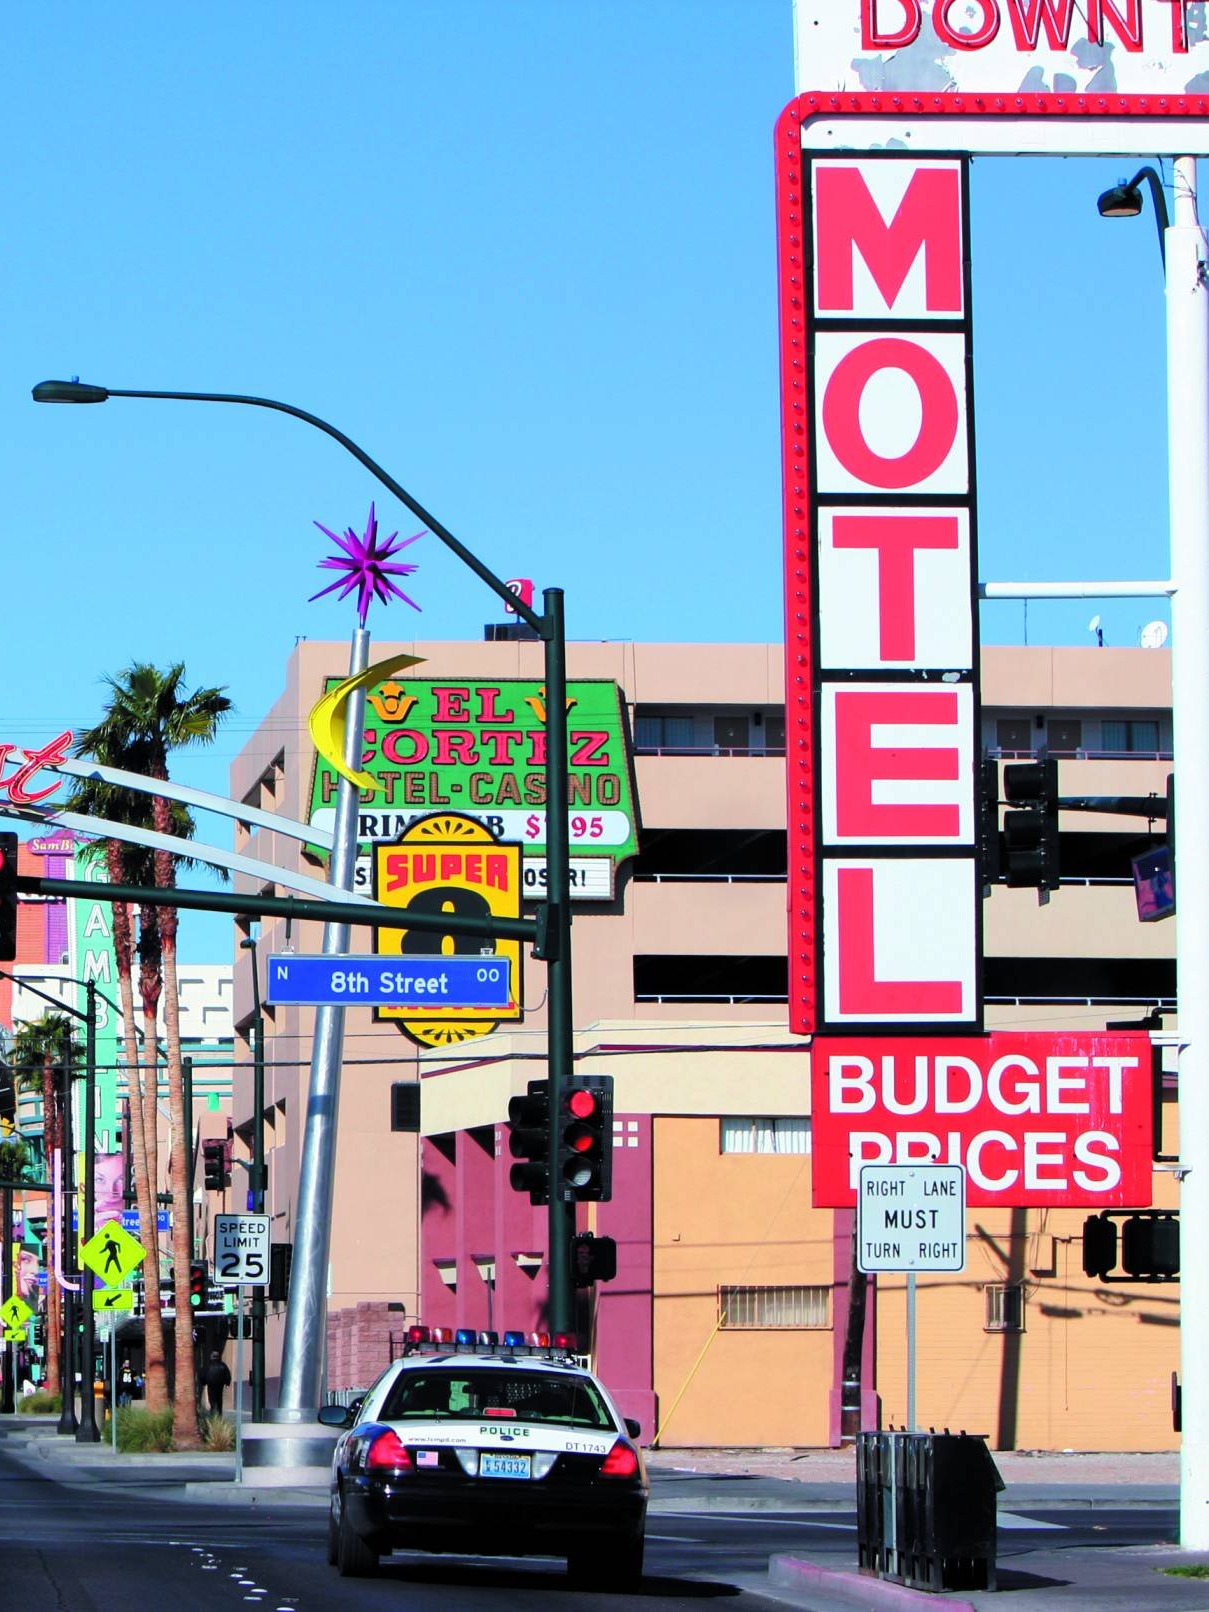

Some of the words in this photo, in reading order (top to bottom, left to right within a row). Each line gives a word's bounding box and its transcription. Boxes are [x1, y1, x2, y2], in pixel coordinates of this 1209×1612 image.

[815, 167, 963, 1014] MOTEL
[431, 687, 515, 723] EL
[525, 813, 604, 839] $95
[387, 854, 509, 893] SUPER
[277, 966, 288, 980] N
[331, 972, 369, 994] 8th
[379, 972, 448, 995] Street
[828, 1055, 1139, 1115] BUDGET
[867, 1181, 905, 1196] RIGHT
[923, 1181, 956, 1196] LANE
[220, 1223, 265, 1233] SPEED
[884, 1210, 939, 1229] MUST
[224, 1237, 260, 1248] LIMIT
[866, 1243, 901, 1258] TURN
[919, 1243, 957, 1258] RIGHT
[221, 1253, 264, 1278] 25
[480, 1426, 530, 1437] POLICE
[565, 1441, 579, 1452] DT
[582, 1443, 607, 1454] 1743
[494, 1460, 527, 1474] 54332
